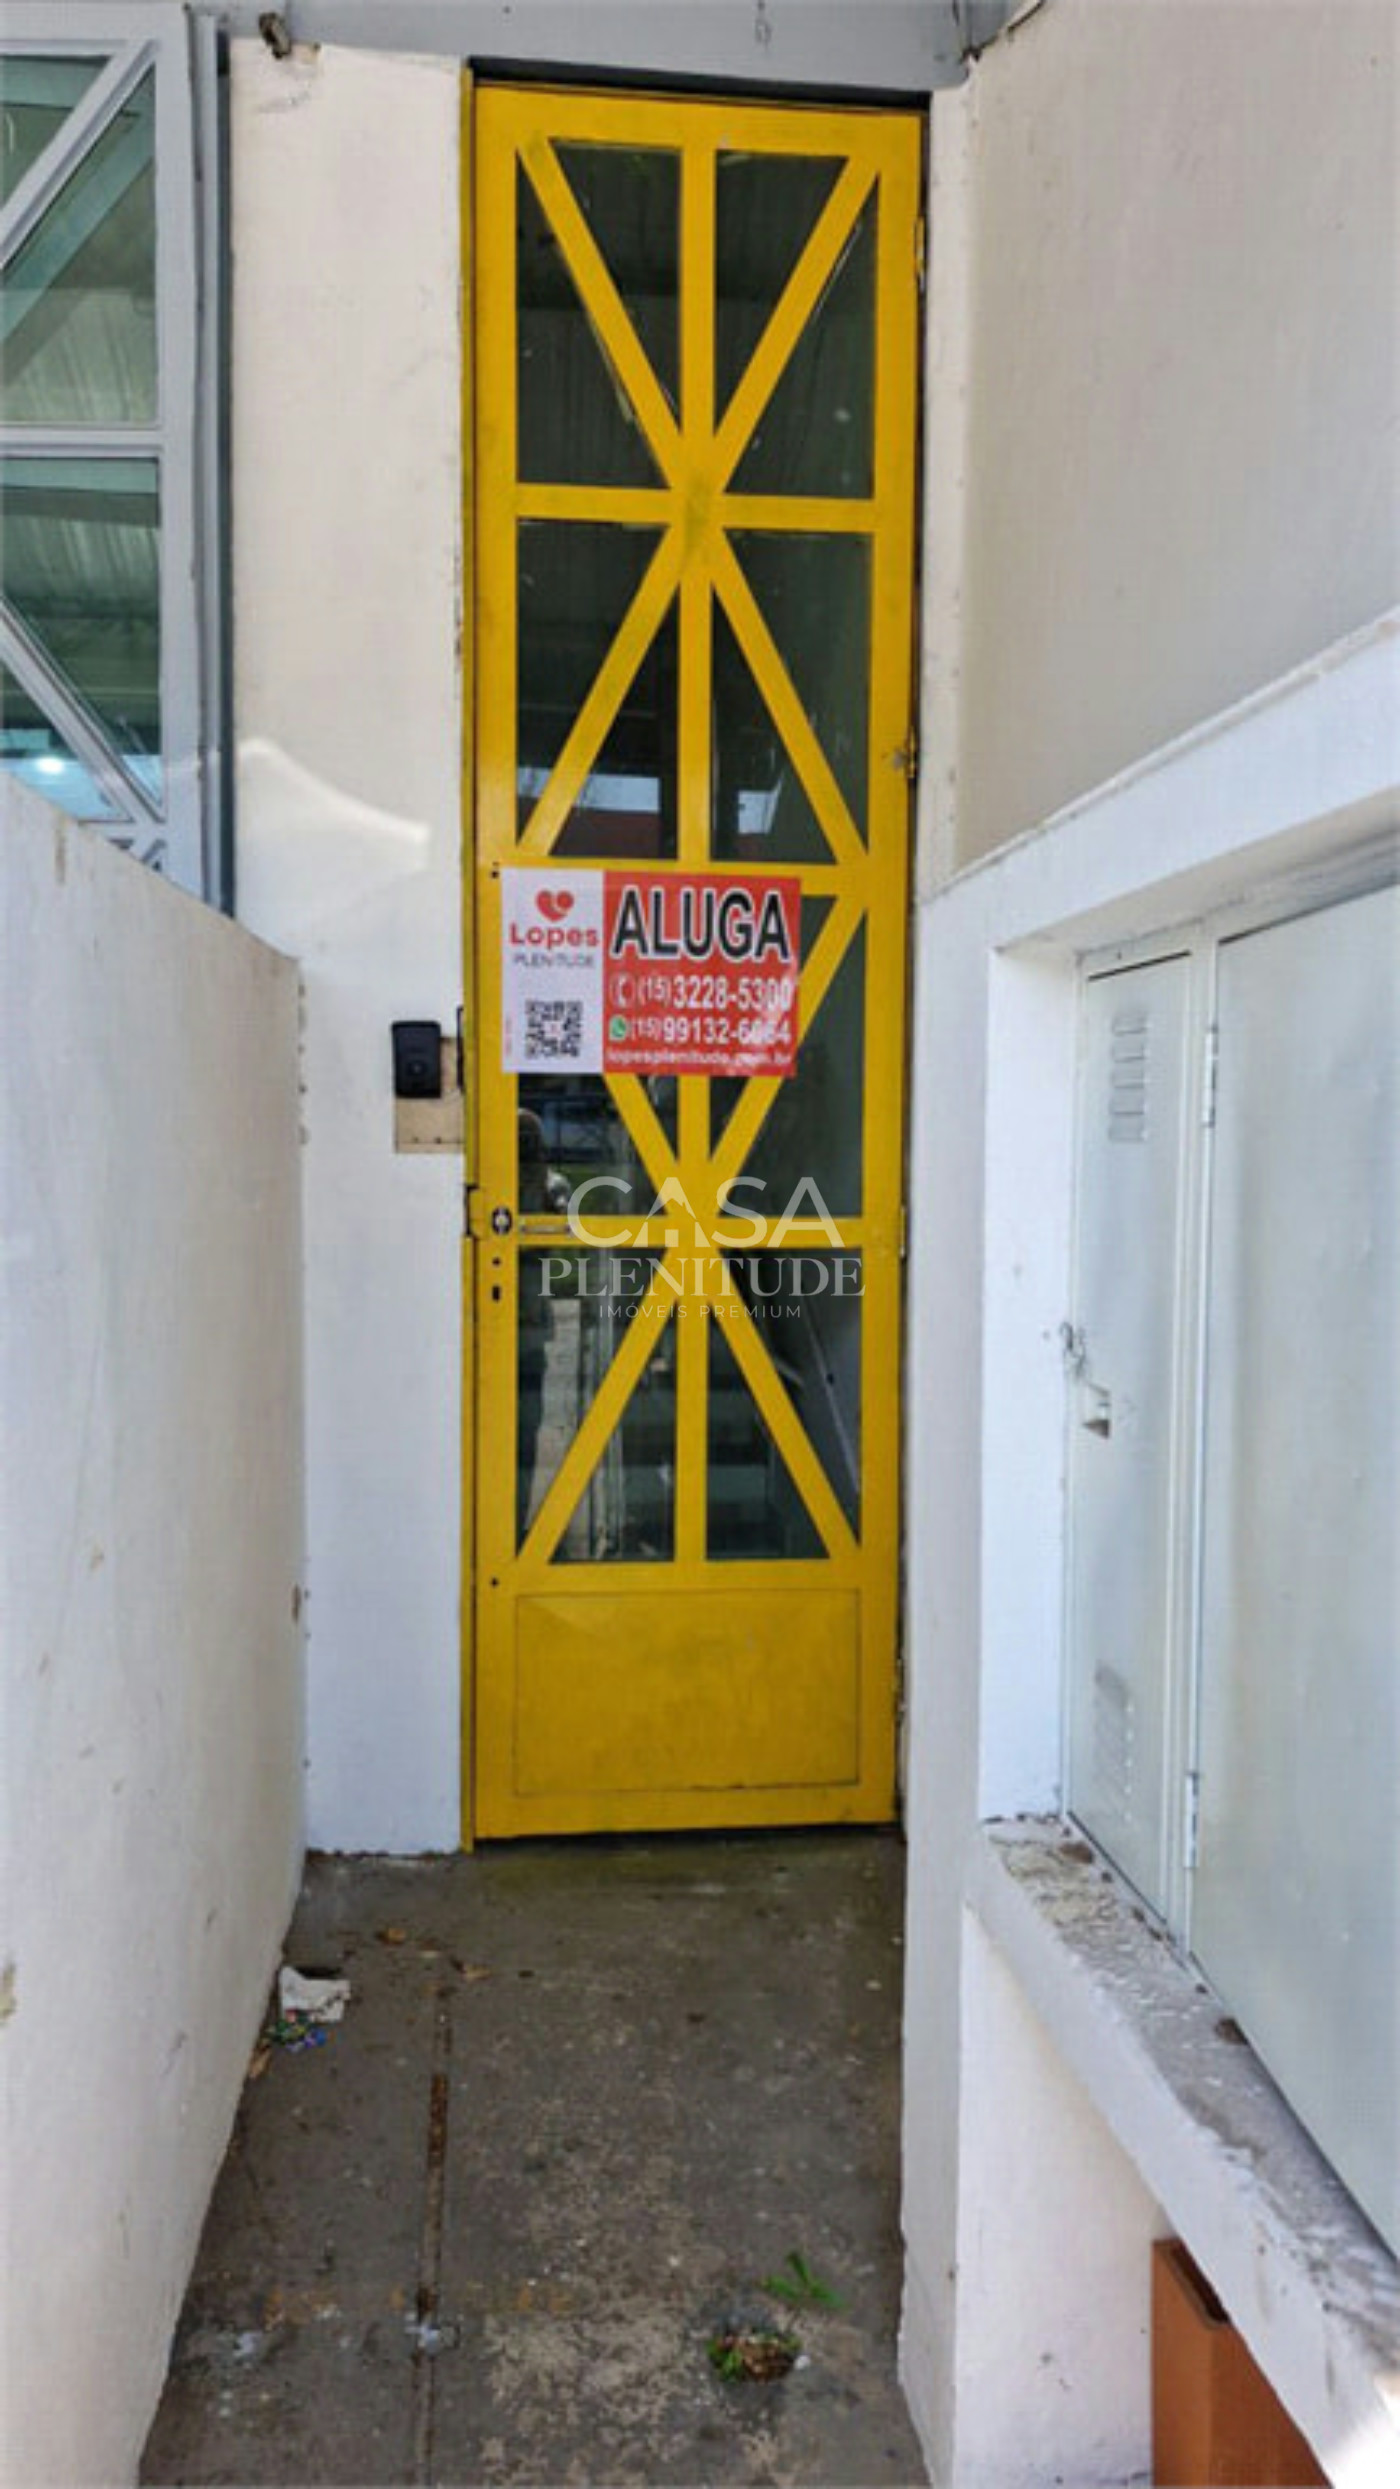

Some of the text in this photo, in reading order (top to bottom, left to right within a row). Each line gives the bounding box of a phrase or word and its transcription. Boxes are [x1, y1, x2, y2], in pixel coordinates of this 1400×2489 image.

[510, 922, 599, 949] Lopes
[610, 885, 791, 961] ALUGA
[512, 952, 595, 968] PLENITUDE
